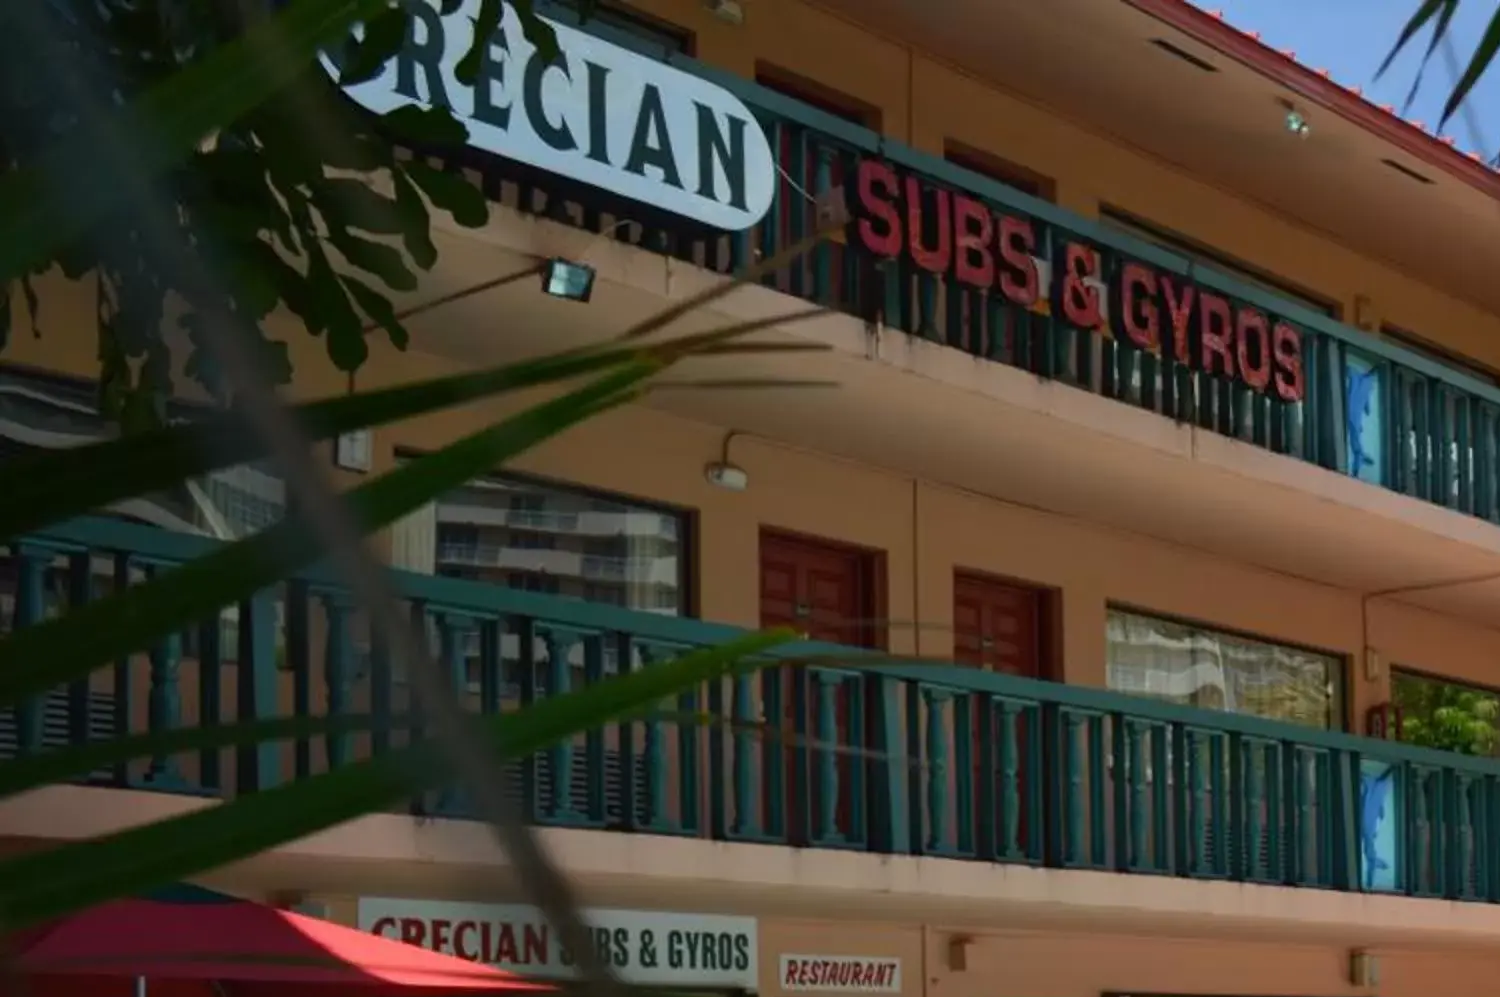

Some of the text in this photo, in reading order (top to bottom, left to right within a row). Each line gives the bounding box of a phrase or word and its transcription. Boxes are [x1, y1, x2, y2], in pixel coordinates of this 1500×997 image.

[857, 159, 1304, 402] SUBS & GYROS
[560, 926, 629, 968] SBS
[639, 929, 658, 969] &
[668, 930, 749, 971] GYROS
[785, 959, 897, 988] RESTAURANT
